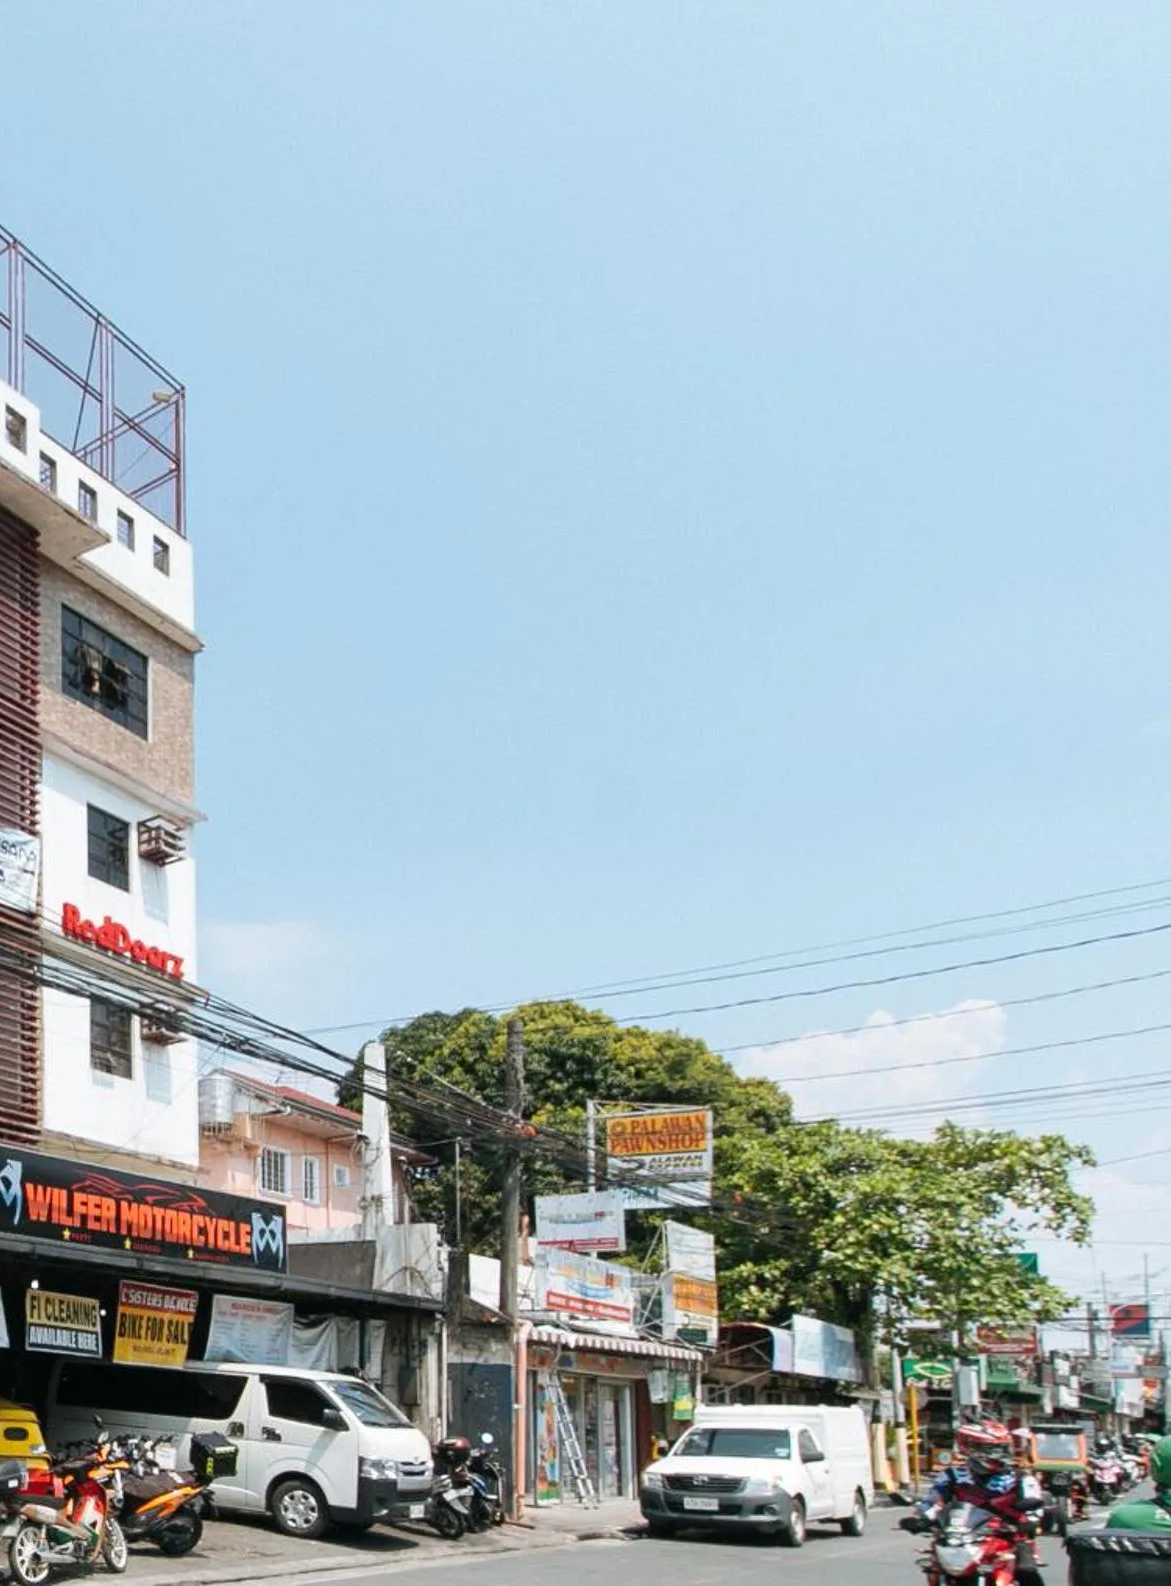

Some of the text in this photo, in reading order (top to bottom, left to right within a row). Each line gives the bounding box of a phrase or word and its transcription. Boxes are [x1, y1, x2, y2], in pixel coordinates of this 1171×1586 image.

[62, 902, 184, 979] RedDoorz
[631, 1115, 705, 1134] PALAWAN
[609, 1133, 705, 1154] PAWNSHOP
[25, 1182, 251, 1254] WILFER MOTORCYCLE
[30, 1295, 98, 1327] FI CLEANING
[30, 1325, 98, 1350] AVAILABLE HERE
[118, 1312, 143, 1340] BIKE
[144, 1316, 165, 1342] FOR
